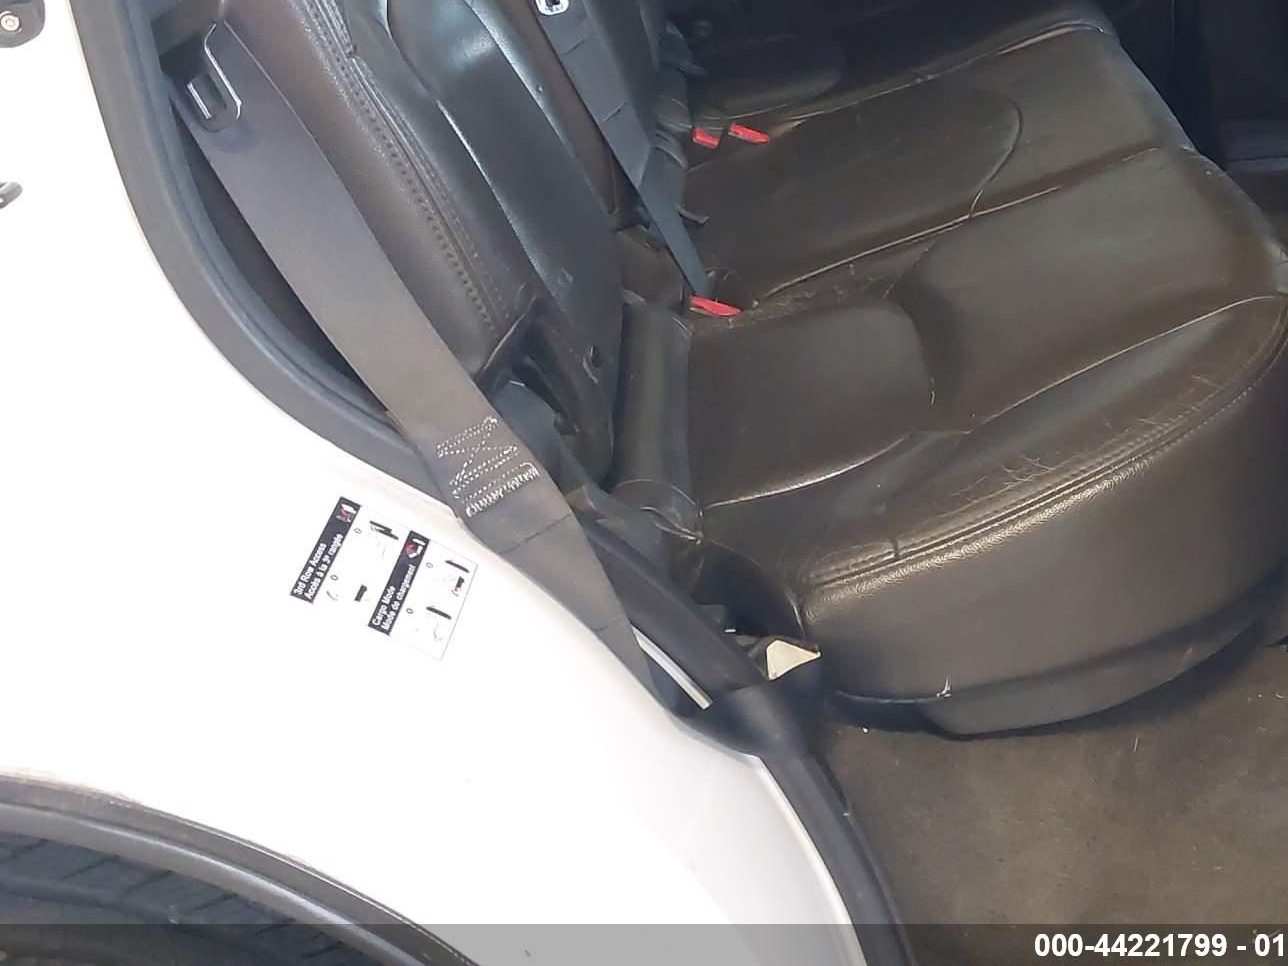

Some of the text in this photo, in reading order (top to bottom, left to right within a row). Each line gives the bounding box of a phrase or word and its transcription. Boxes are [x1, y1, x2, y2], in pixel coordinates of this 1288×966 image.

[293, 542, 327, 595] 3rd Row Access
[318, 563, 328, 572] la
[372, 585, 396, 626] Cargo Mode
[380, 610, 396, 631] Mode
[391, 600, 401, 611] de
[396, 564, 417, 601] chargement
